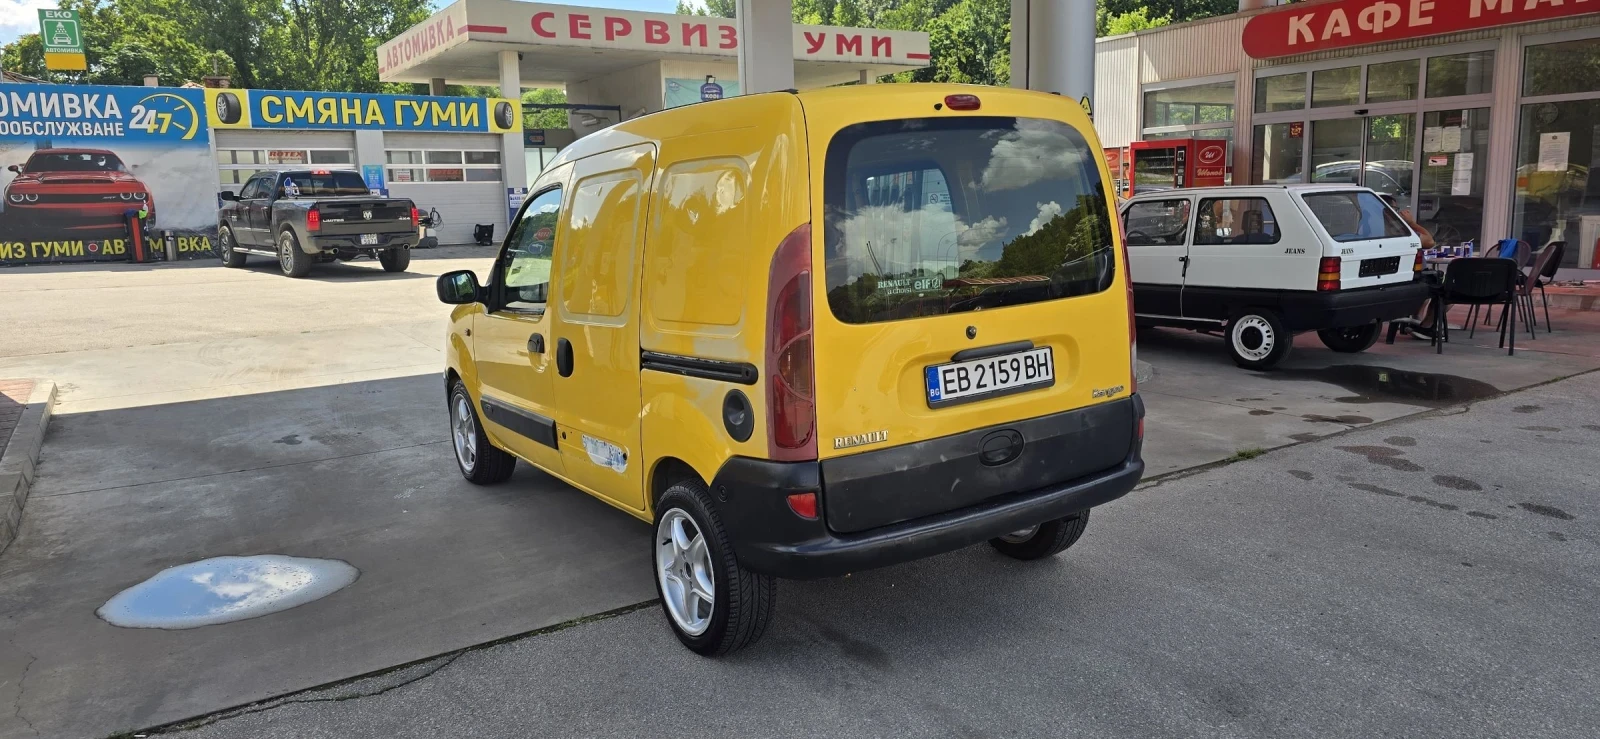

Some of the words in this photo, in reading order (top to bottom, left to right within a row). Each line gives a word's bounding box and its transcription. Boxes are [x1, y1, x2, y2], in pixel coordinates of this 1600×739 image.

[531, 12, 738, 49] СЕРВИЗ
[804, 32, 892, 58] УМИ
[1288, 0, 1433, 46] КАФЕ
[386, 15, 455, 71] АВТОМИВКА
[260, 95, 386, 126] СМЯНА
[394, 101, 480, 128] ГУМИ
[31, 241, 84, 258] ГУМИ
[102, 237, 212, 255] АВМВКА
[878, 279, 911, 288] RENAULT
[914, 279, 932, 290] elf
[942, 367, 971, 395] EB
[974, 358, 1021, 389] 2159
[1024, 352, 1049, 380] BH
[930, 388, 940, 397] BG
[834, 430, 888, 449] RENAULT
